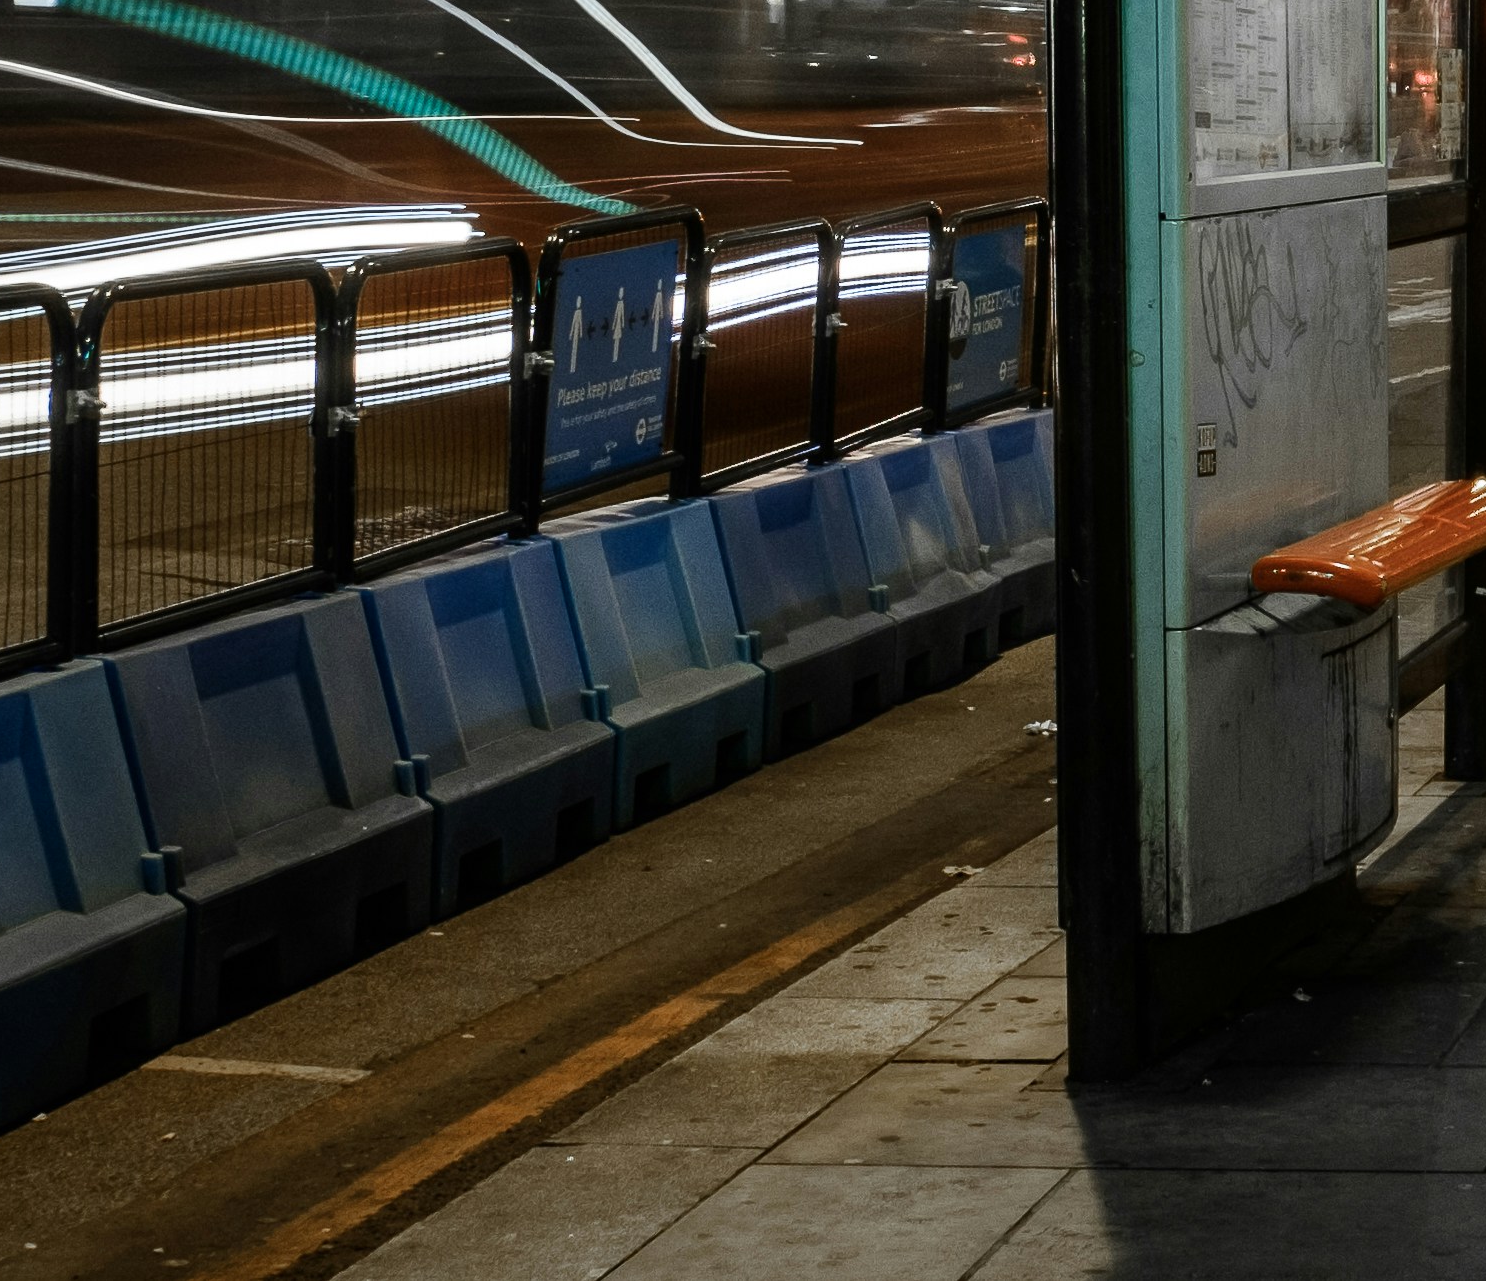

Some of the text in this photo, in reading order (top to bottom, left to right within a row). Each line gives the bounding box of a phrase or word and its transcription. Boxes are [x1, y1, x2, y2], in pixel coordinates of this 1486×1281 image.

[556, 386, 586, 409] Please
[586, 381, 608, 400] keep
[608, 375, 628, 398] your
[629, 367, 662, 387] distance
